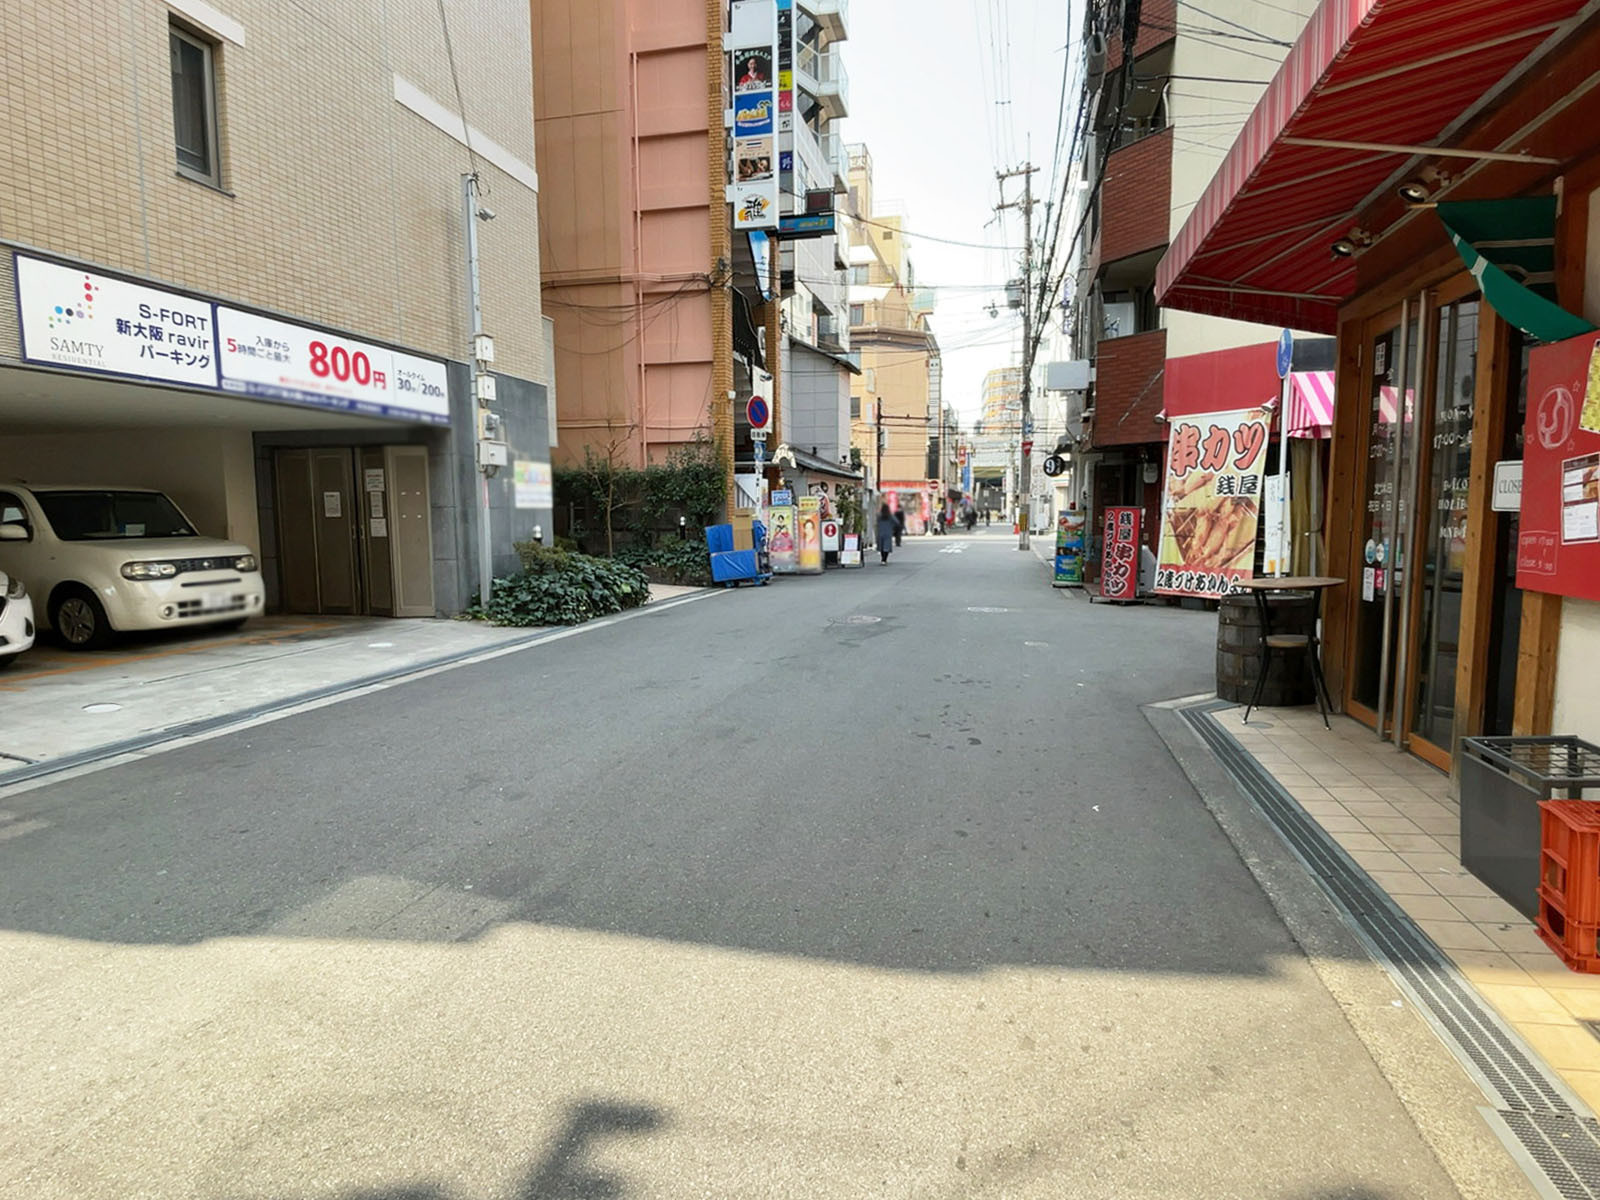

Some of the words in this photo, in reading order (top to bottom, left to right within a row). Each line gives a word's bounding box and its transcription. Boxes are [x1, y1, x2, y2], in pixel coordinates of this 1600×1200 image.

[139, 303, 208, 331] S-FORT
[50, 336, 104, 358] SAMTY
[116, 318, 163, 342] 新大阪
[168, 332, 209, 350] ravir
[140, 344, 210, 369] パーキング
[308, 340, 387, 390] 800円
[1171, 421, 1265, 477] 串カツ
